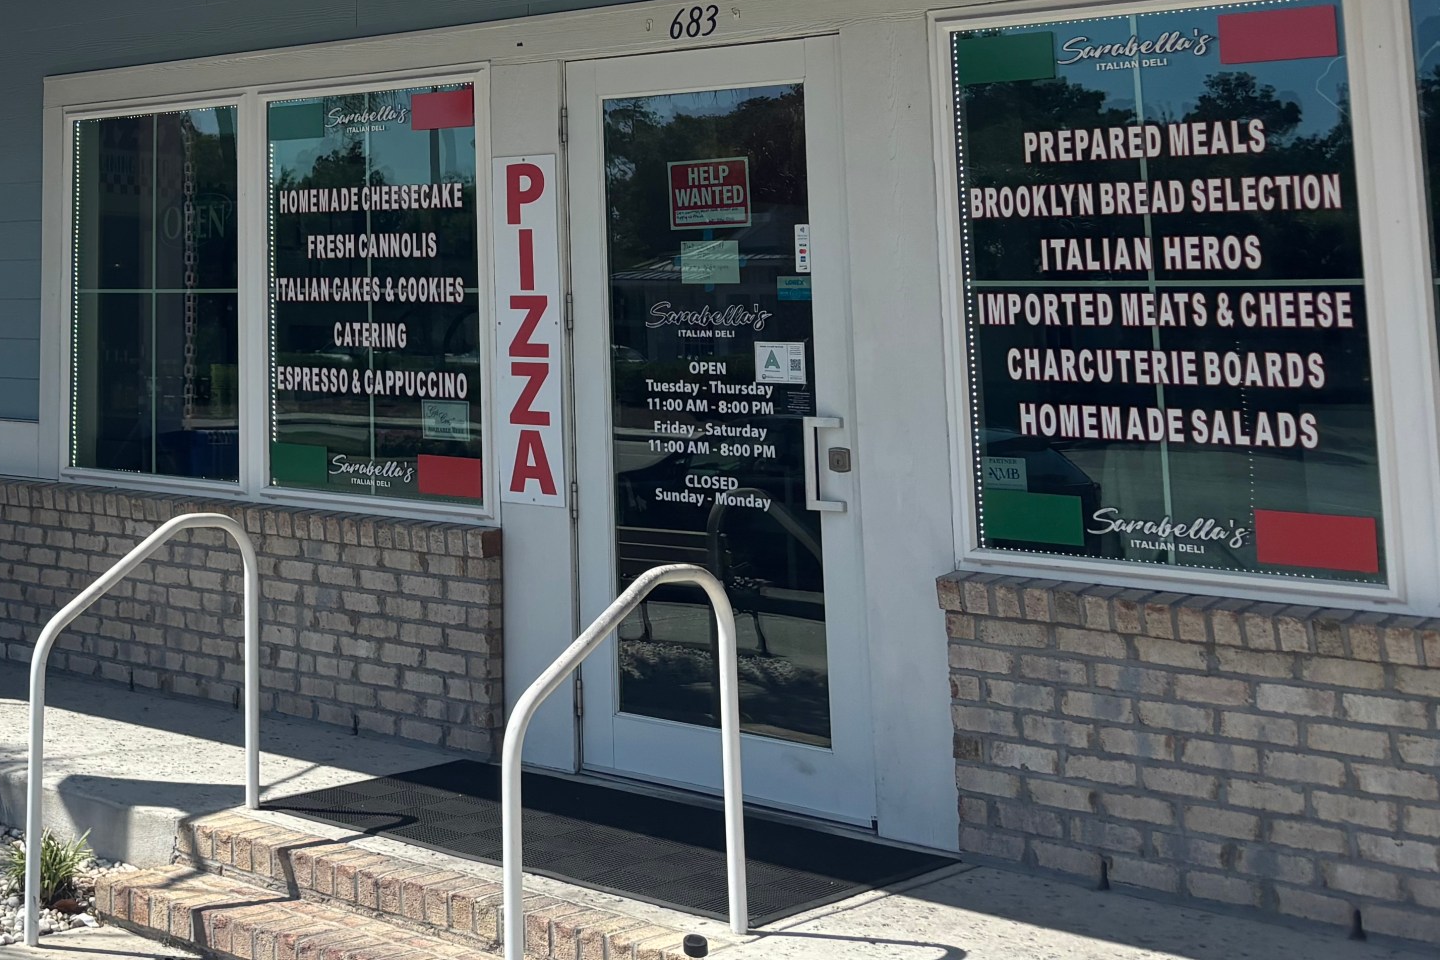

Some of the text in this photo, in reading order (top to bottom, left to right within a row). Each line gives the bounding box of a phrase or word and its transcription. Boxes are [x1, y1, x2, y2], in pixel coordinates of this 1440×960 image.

[669, 4, 719, 39] 683
[1057, 28, 1215, 65] Sarabella's
[1095, 58, 1168, 71] ITALIAN DELI
[325, 104, 408, 128] Sarabella's
[346, 124, 385, 133] ITALIAN DELI
[1023, 119, 1266, 164] PREPARED MEALS
[687, 165, 729, 186] HELP
[279, 183, 463, 214] HOMEMADE CHEESECAKE
[675, 185, 744, 207] WANTED
[970, 173, 1342, 219] BROOKLYN BREAD SELECTION
[307, 231, 437, 259] FRESH CANNOLIS
[1040, 234, 1262, 271] ITALIAN HEROS
[275, 277, 464, 303] ITALIAN CAKES & COOKIES
[645, 301, 772, 331] Sarabella's
[977, 292, 1354, 328] IMPORTED MEATS & CHEESE
[334, 321, 407, 348] CATERING
[505, 163, 558, 496] PIZZA
[678, 330, 735, 338] ITALIAN DELI
[689, 362, 727, 374] OPEN
[1007, 348, 1325, 388] CHARCUTERIE BOARDS
[277, 366, 468, 399] ESPRESSO & CAPPUCCINO
[646, 379, 699, 396] Tuesday
[709, 381, 773, 398] Thursday
[647, 398, 683, 411] 11:00
[686, 399, 708, 412] AM
[718, 400, 748, 414] 8:00
[752, 401, 774, 415] PM
[654, 420, 695, 437] Friday
[705, 423, 767, 441] Saturday
[1019, 403, 1319, 449] HOMEMADE SALADS
[648, 439, 684, 453] 11:00
[687, 441, 709, 454] AM
[720, 443, 750, 457] 8:00
[754, 444, 776, 458] PM
[328, 454, 414, 482] Sarabella's
[351, 477, 391, 487] ITALIAN DELI
[685, 474, 738, 490] CLOSED
[655, 488, 704, 507] Sunday
[715, 492, 771, 512] Monday
[1087, 507, 1249, 549] Sarabella's
[1131, 539, 1205, 554] ITALIAN DELI
